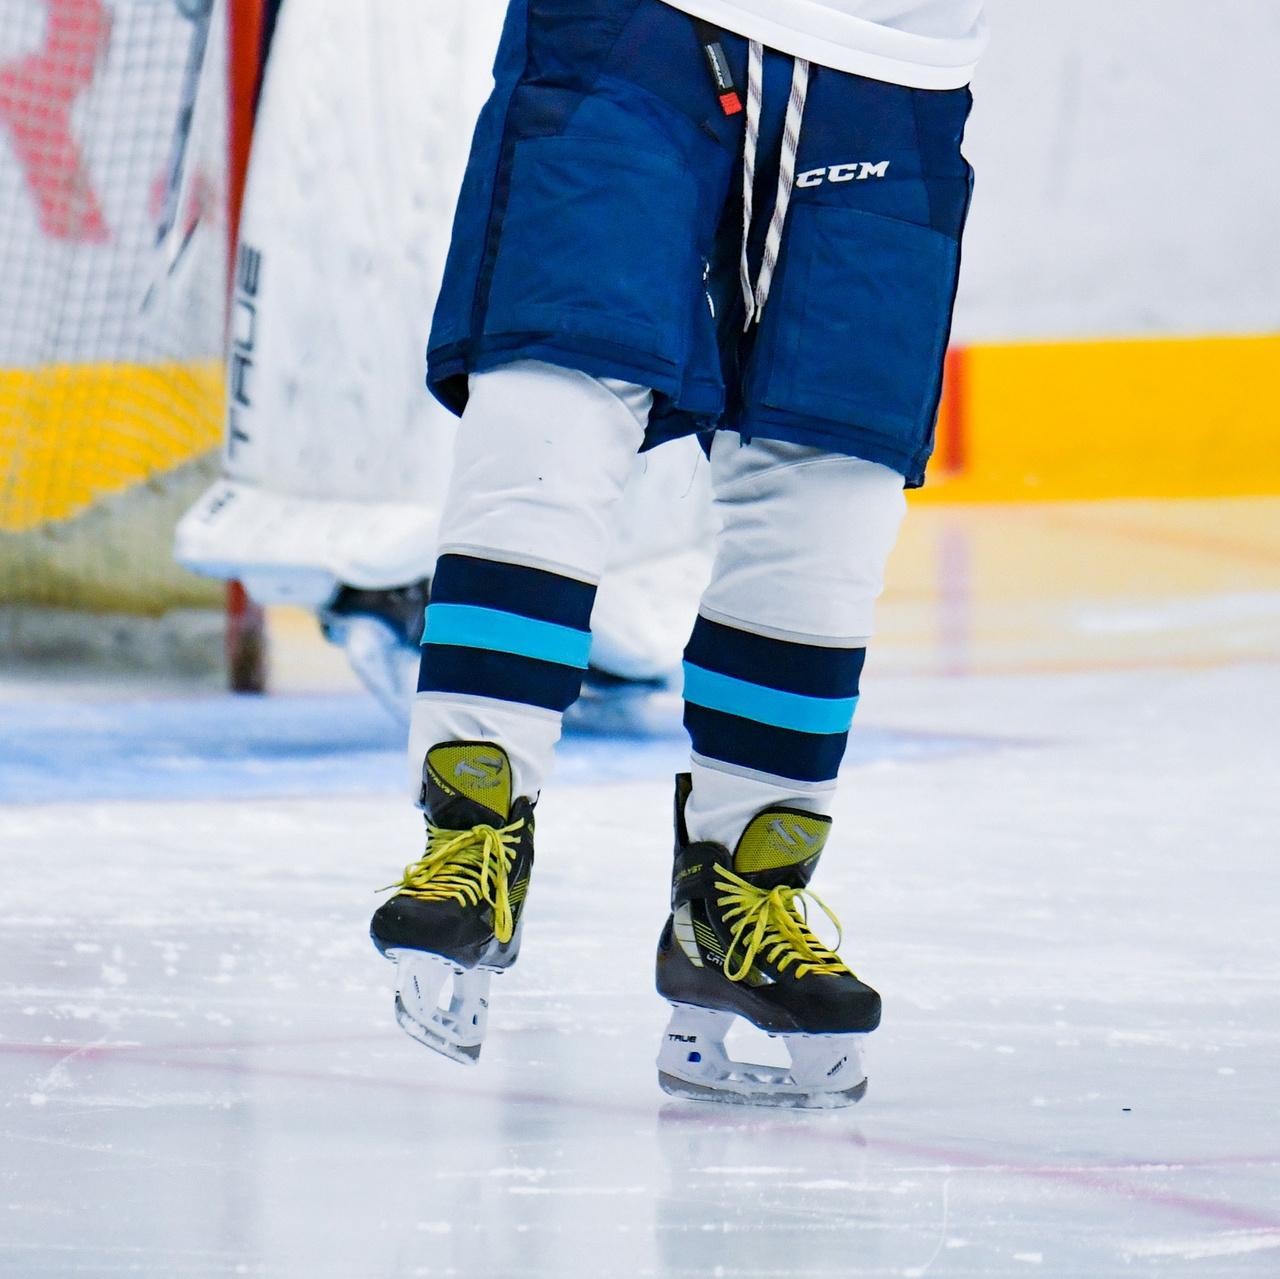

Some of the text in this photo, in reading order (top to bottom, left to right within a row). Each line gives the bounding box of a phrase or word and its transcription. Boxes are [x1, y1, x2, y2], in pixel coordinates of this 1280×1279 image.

[796, 160, 890, 188] CCM
[229, 243, 261, 460] TRUE
[668, 1033, 698, 1043] TRUE
